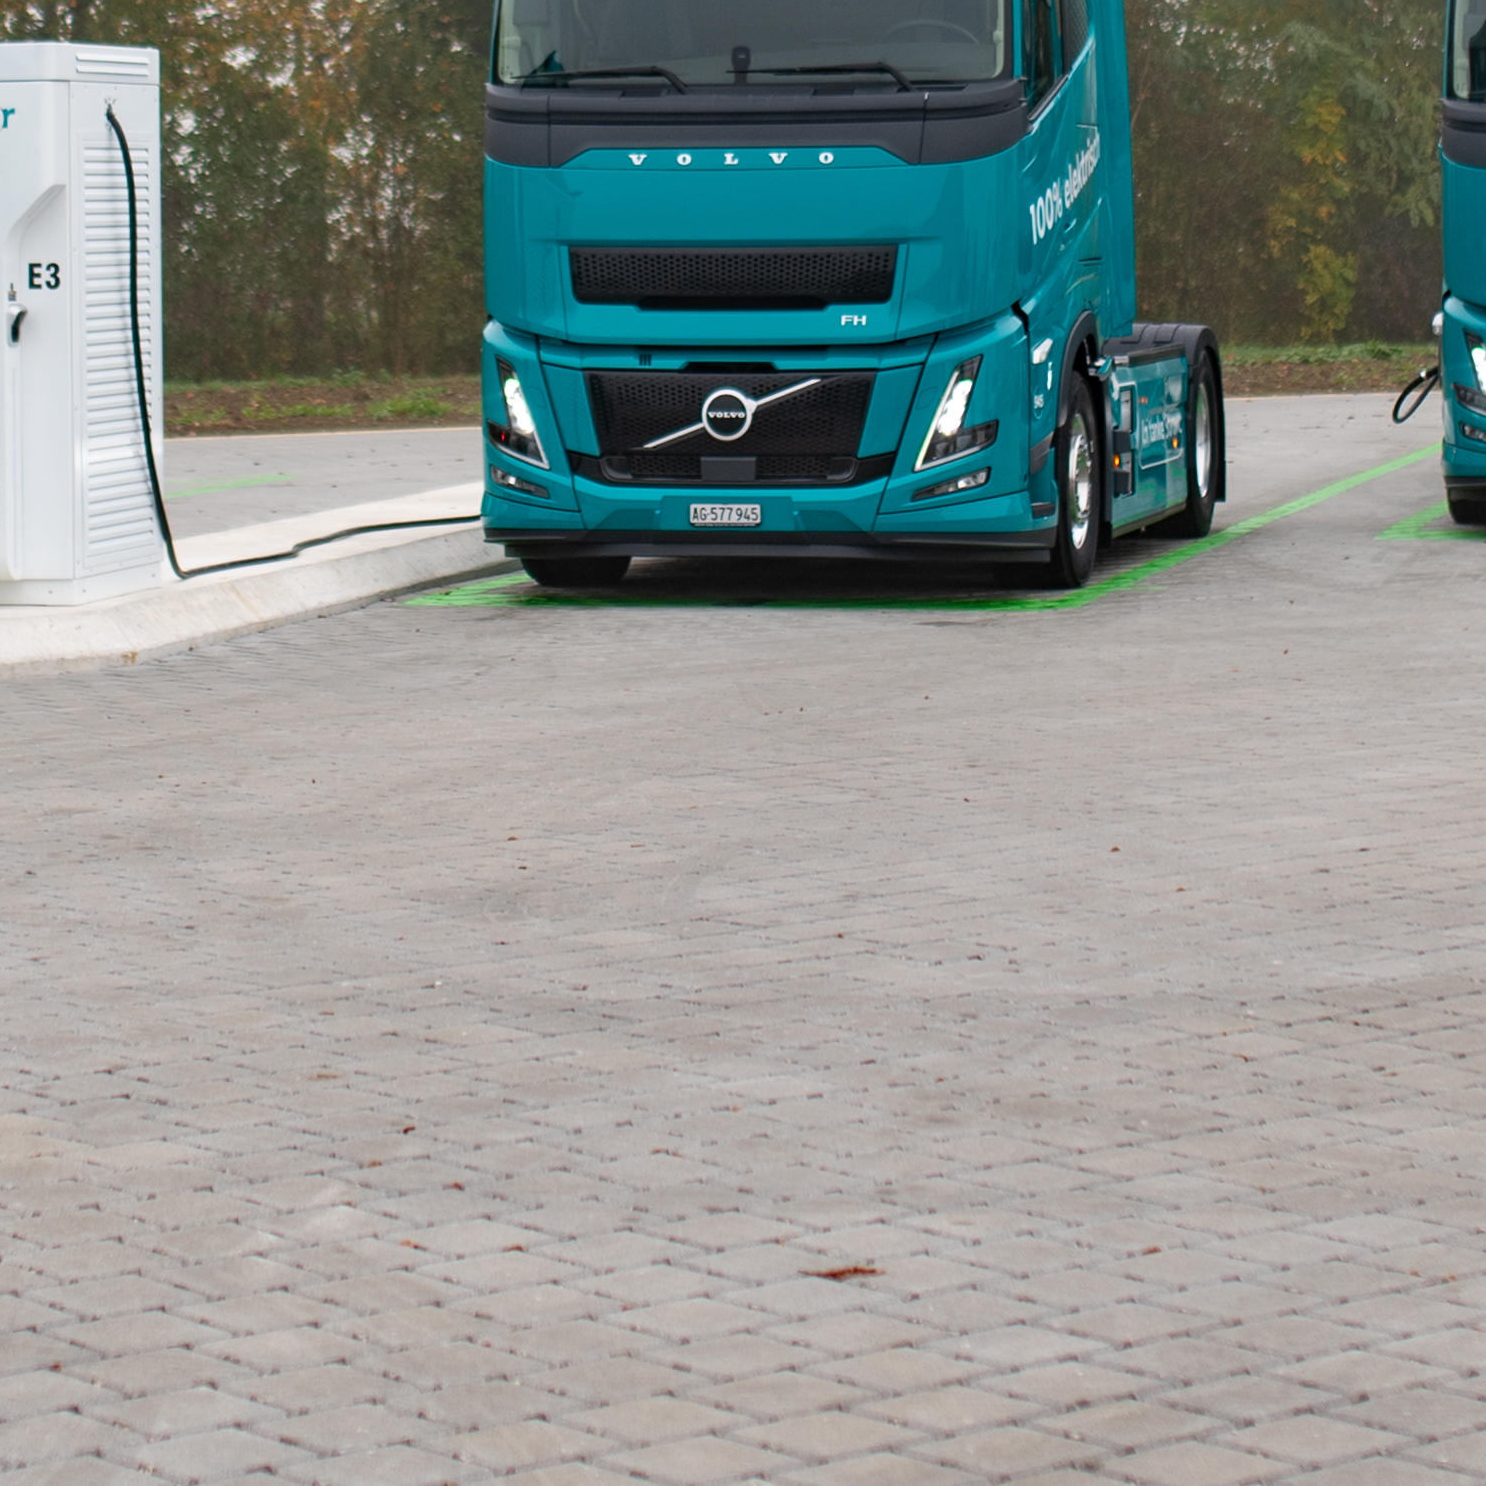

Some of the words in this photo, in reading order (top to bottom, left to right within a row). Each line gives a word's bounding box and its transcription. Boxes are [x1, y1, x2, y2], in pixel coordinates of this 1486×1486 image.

[628, 151, 835, 166] VOLVO
[1029, 176, 1063, 246] 100%
[28, 262, 61, 290] E3
[840, 314, 867, 326] FH
[707, 411, 746, 419] VOLVO
